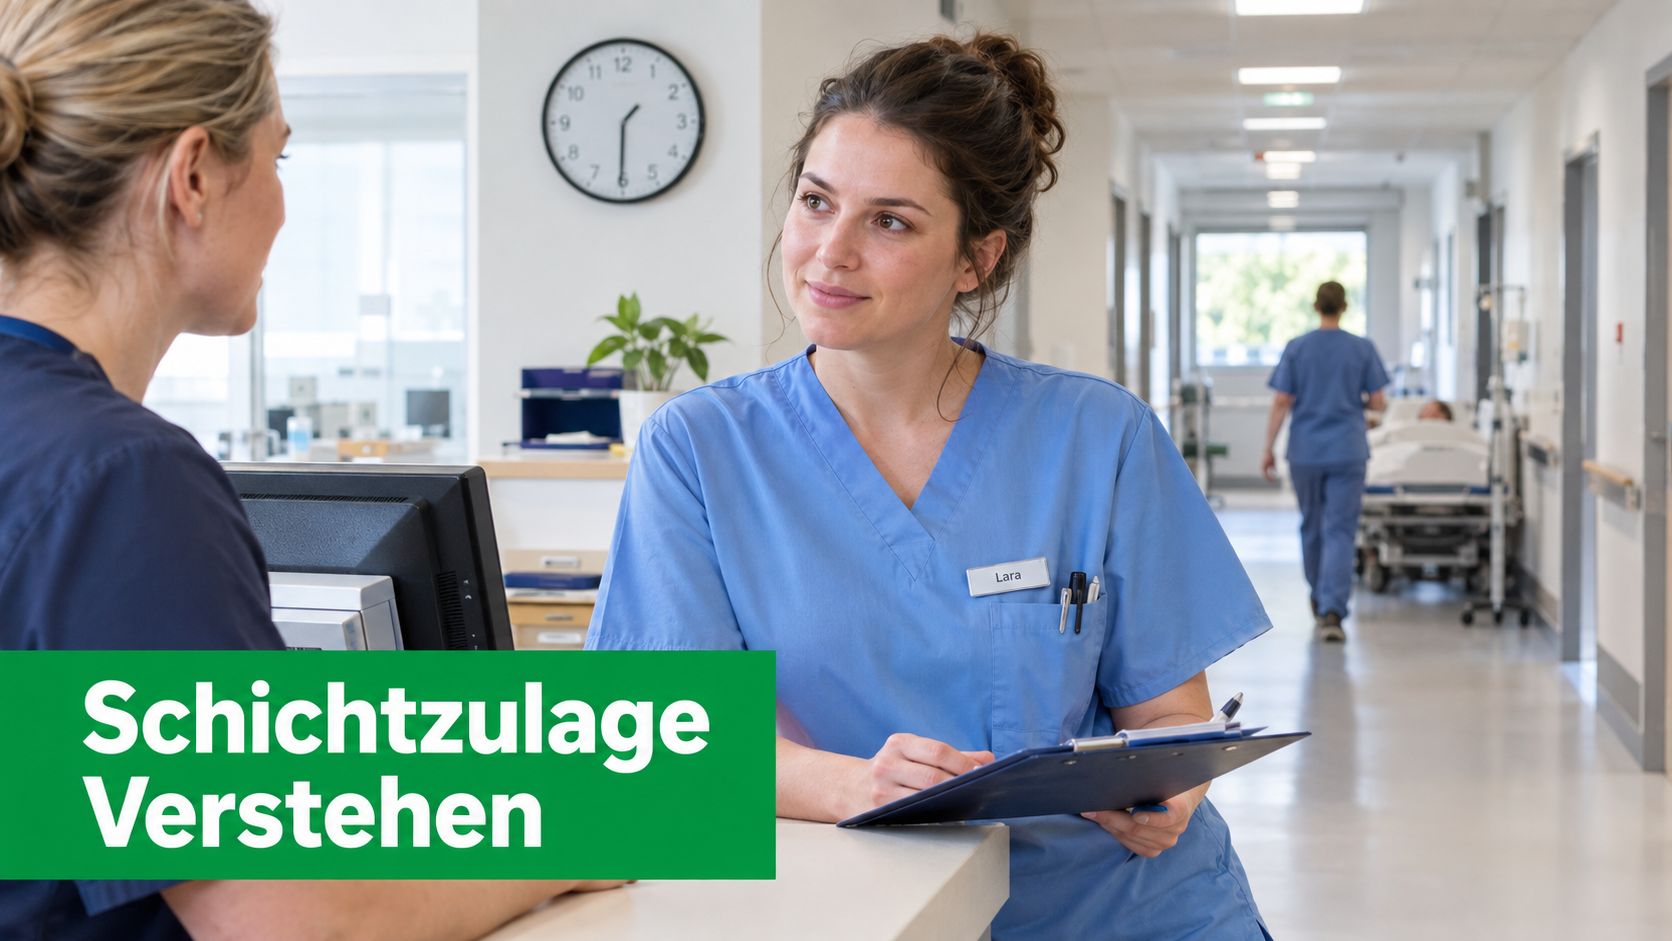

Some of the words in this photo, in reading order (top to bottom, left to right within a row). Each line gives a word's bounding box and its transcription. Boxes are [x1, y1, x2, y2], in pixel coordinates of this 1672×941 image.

[588, 65, 602, 80] 11
[614, 56, 632, 73] 12
[649, 64, 656, 79] 1
[567, 86, 584, 102] 10
[667, 84, 678, 100] 2
[559, 115, 570, 131] 9
[676, 114, 687, 130] 3
[567, 144, 579, 160] 8
[667, 144, 678, 158] 4
[590, 165, 600, 179] 7
[647, 164, 658, 180] 5
[995, 571, 1022, 583] Lara
